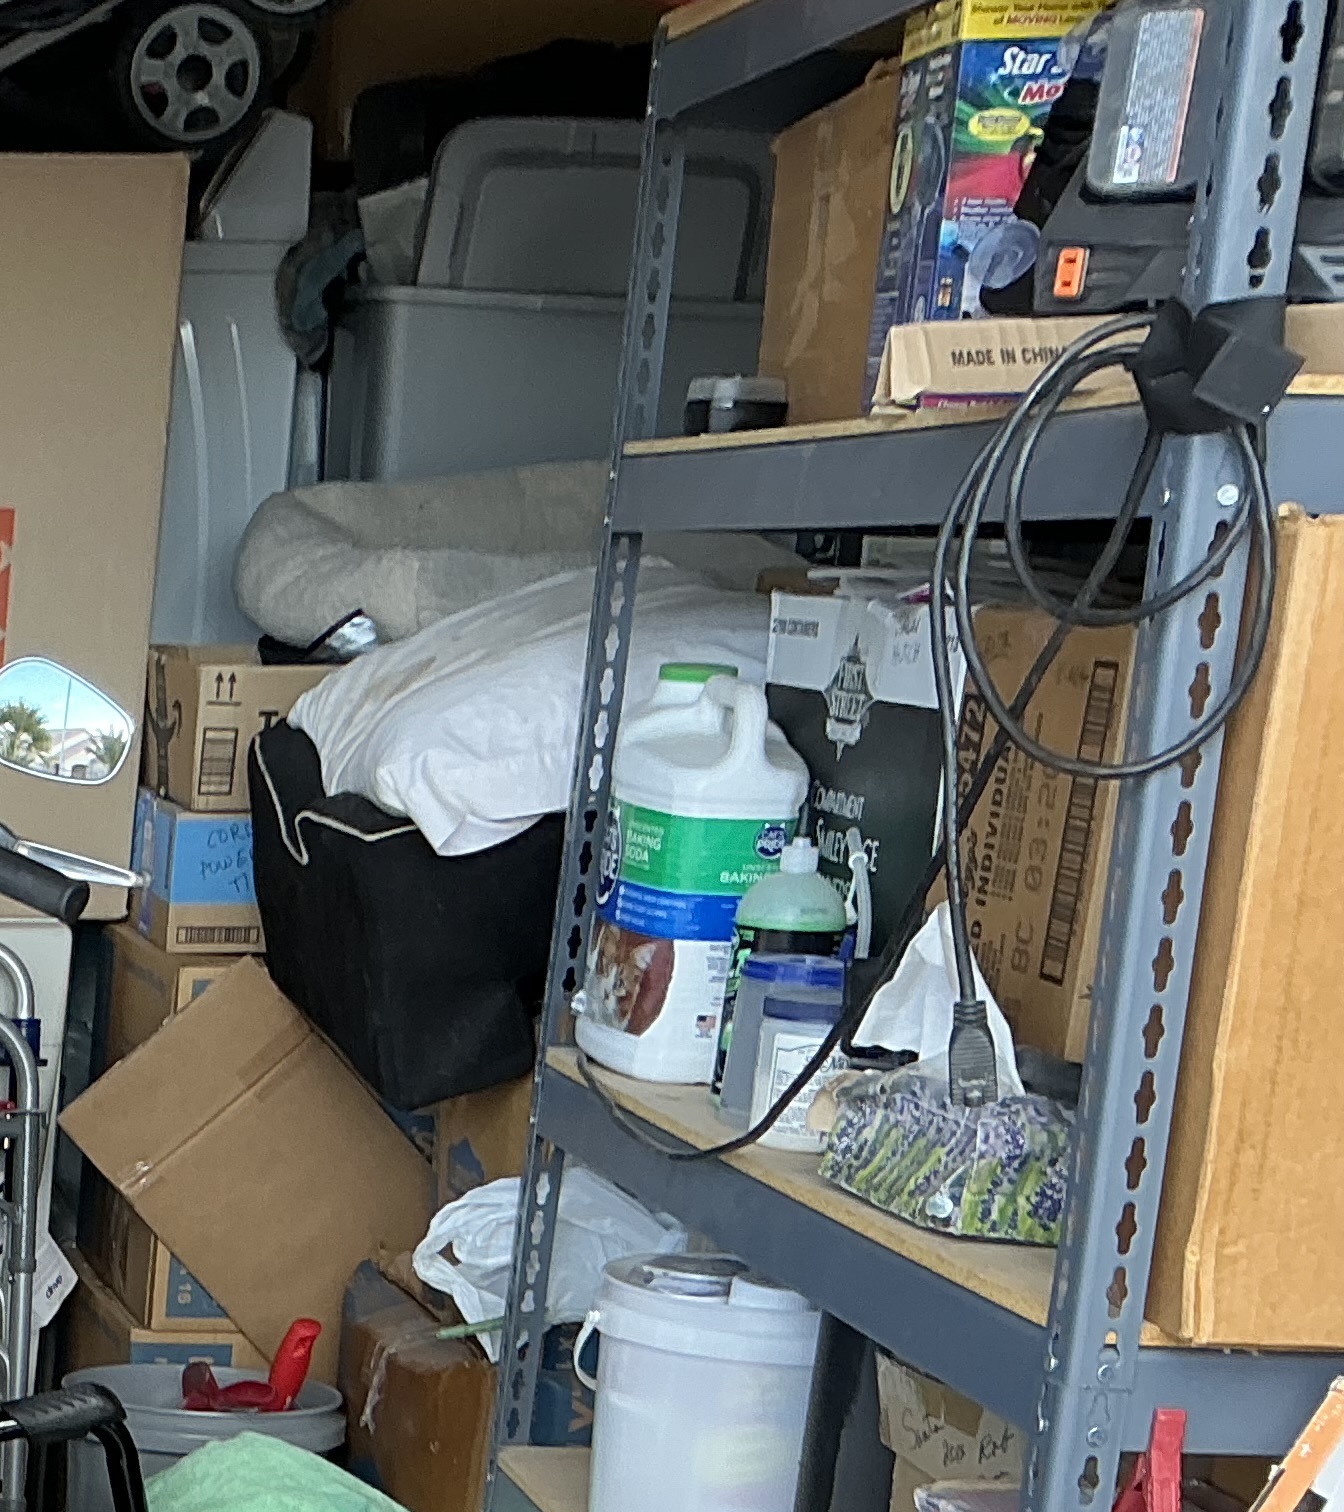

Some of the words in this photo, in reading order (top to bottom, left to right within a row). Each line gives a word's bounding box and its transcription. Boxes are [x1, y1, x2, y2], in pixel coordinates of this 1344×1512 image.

[998, 45, 1051, 76] Star
[950, 348, 996, 368] MADE
[1000, 346, 1017, 365] IN
[1021, 345, 1069, 364] CHIN
[976, 742, 1012, 908] INDIVIDUA
[626, 829, 662, 851] BAKING
[625, 849, 650, 864] SODA
[719, 871, 764, 884] BAKIN
